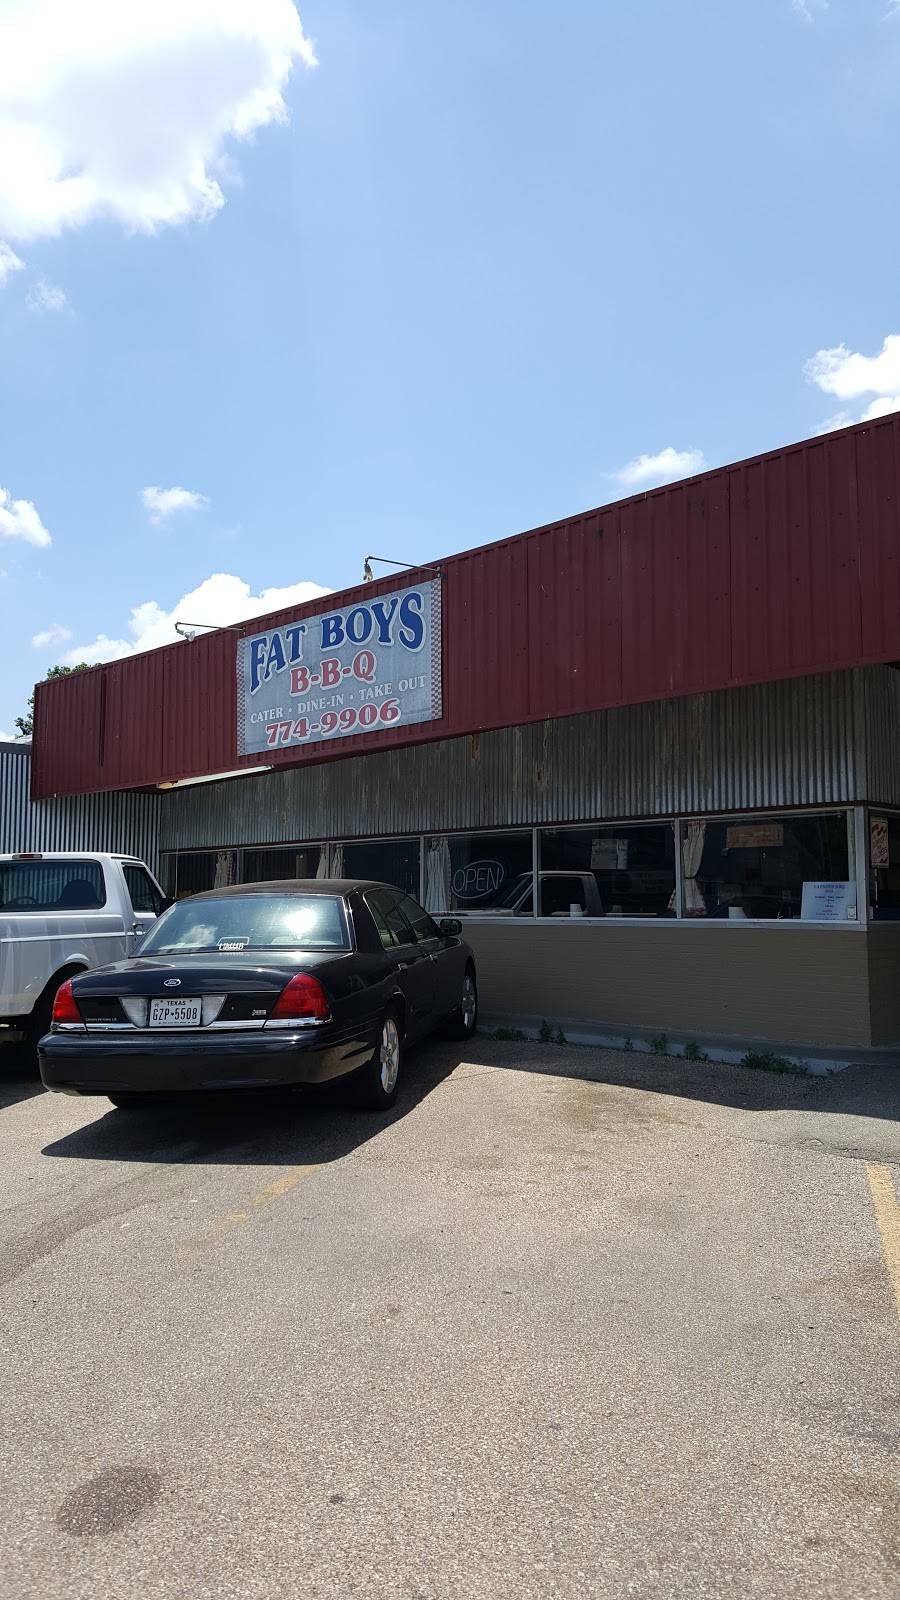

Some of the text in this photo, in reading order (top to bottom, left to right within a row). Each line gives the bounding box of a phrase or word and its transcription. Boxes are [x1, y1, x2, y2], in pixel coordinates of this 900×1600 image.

[250, 592, 424, 694] FAT BOYS
[289, 650, 376, 696] B-B-Q
[250, 675, 427, 723] CATER DINE-IN TAKE OUT
[265, 698, 401, 746] 774-9906
[452, 866, 500, 892] OPEN
